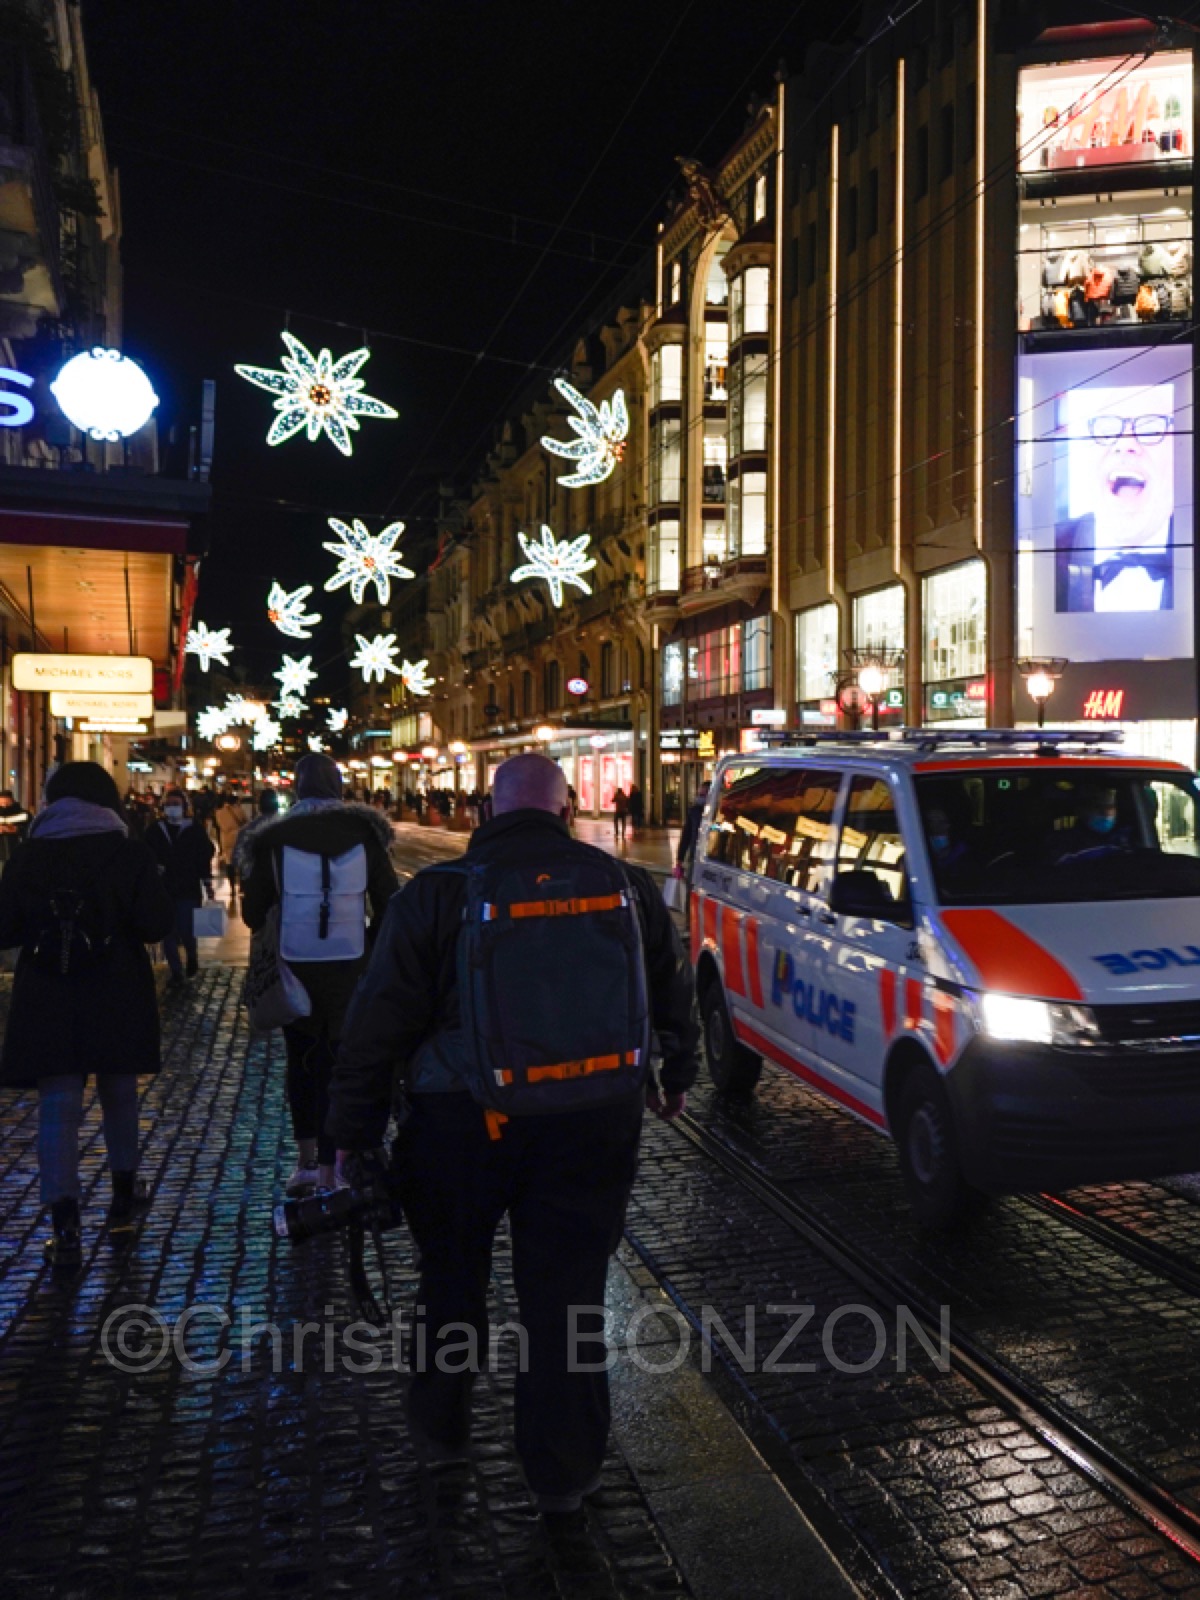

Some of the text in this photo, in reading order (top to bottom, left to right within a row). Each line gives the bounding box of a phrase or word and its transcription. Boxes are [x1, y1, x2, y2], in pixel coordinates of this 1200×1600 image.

[34, 667, 133, 680] MICHAEL KORS
[1083, 689, 1124, 719] H&M
[771, 948, 856, 1044] POLICE
